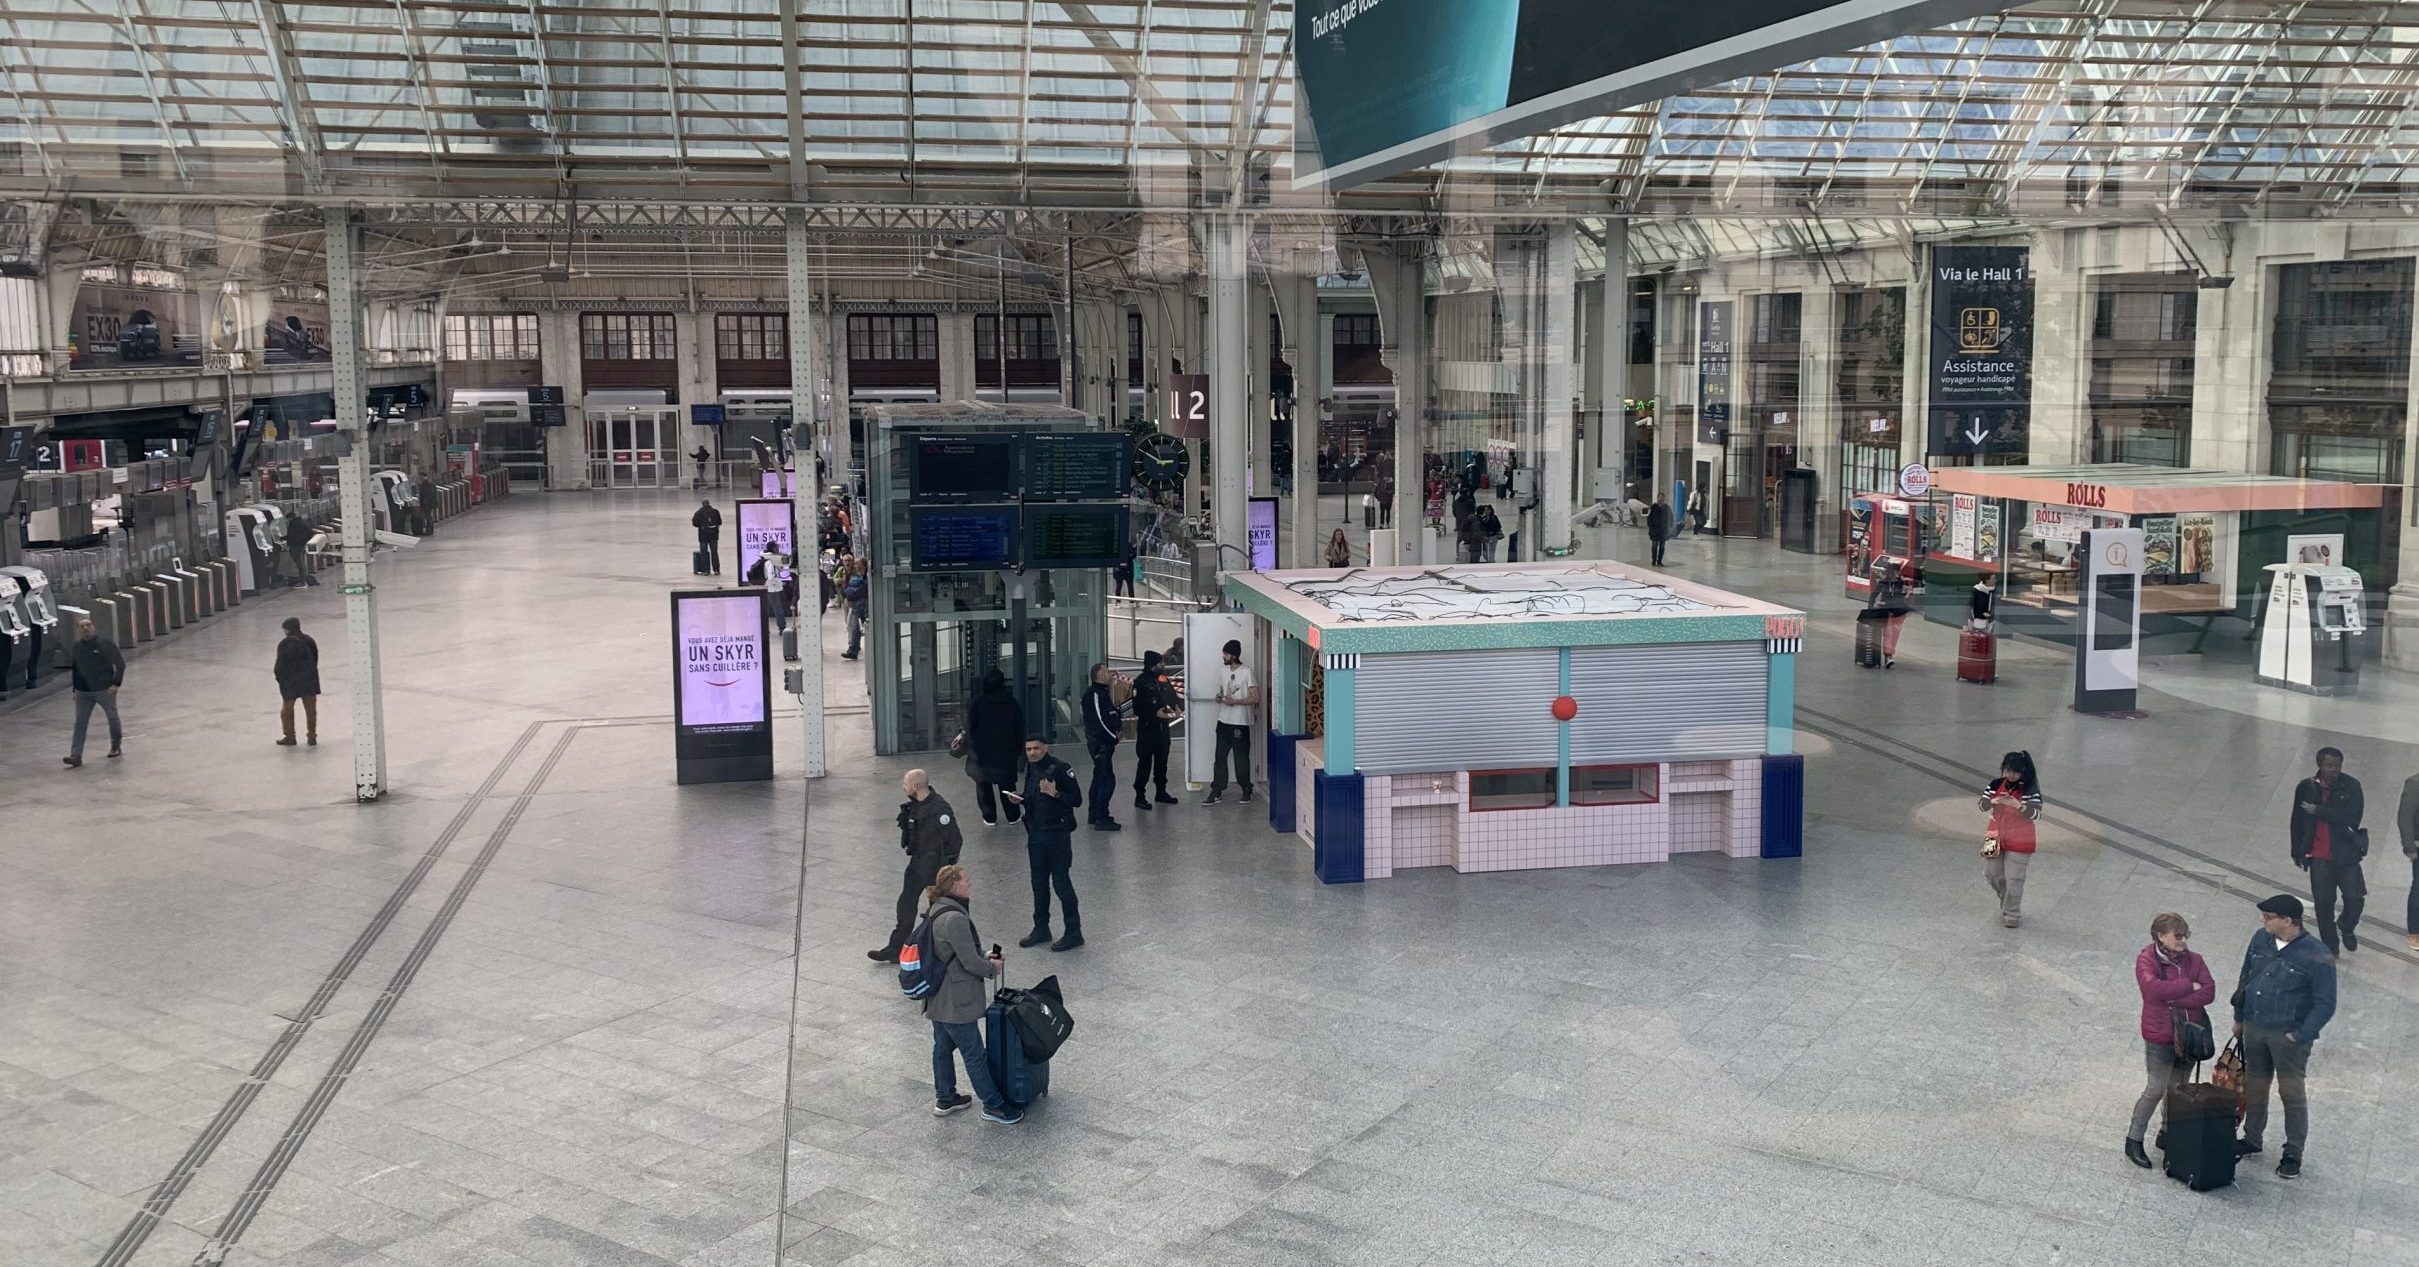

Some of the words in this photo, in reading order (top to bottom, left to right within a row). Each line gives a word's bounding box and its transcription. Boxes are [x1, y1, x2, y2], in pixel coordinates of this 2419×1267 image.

[1312, 11, 1328, 40] Tout
[1329, 8, 1340, 30] ce
[1341, 0, 1356, 29] que
[1940, 268, 1962, 280] Via
[1966, 268, 1979, 280] le
[1983, 268, 2011, 280] Hall
[2016, 268, 2022, 280] 1
[88, 316, 120, 341] EX30
[1710, 341, 1724, 353] Hall
[1725, 341, 1728, 352] 1
[1943, 360, 2014, 372] Assistance
[1940, 376, 1975, 384] voyageur
[1977, 375, 2016, 384] handicapé
[1190, 390, 1205, 420] 2
[38, 446, 50, 462] 2
[746, 533, 759, 543] UN
[762, 532, 786, 542] SKYR
[689, 646, 708, 662] UN
[715, 644, 754, 661] SKYR
[689, 663, 710, 673] SANS
[712, 661, 751, 672] CUILLÈRE
[754, 661, 758, 670] ?
